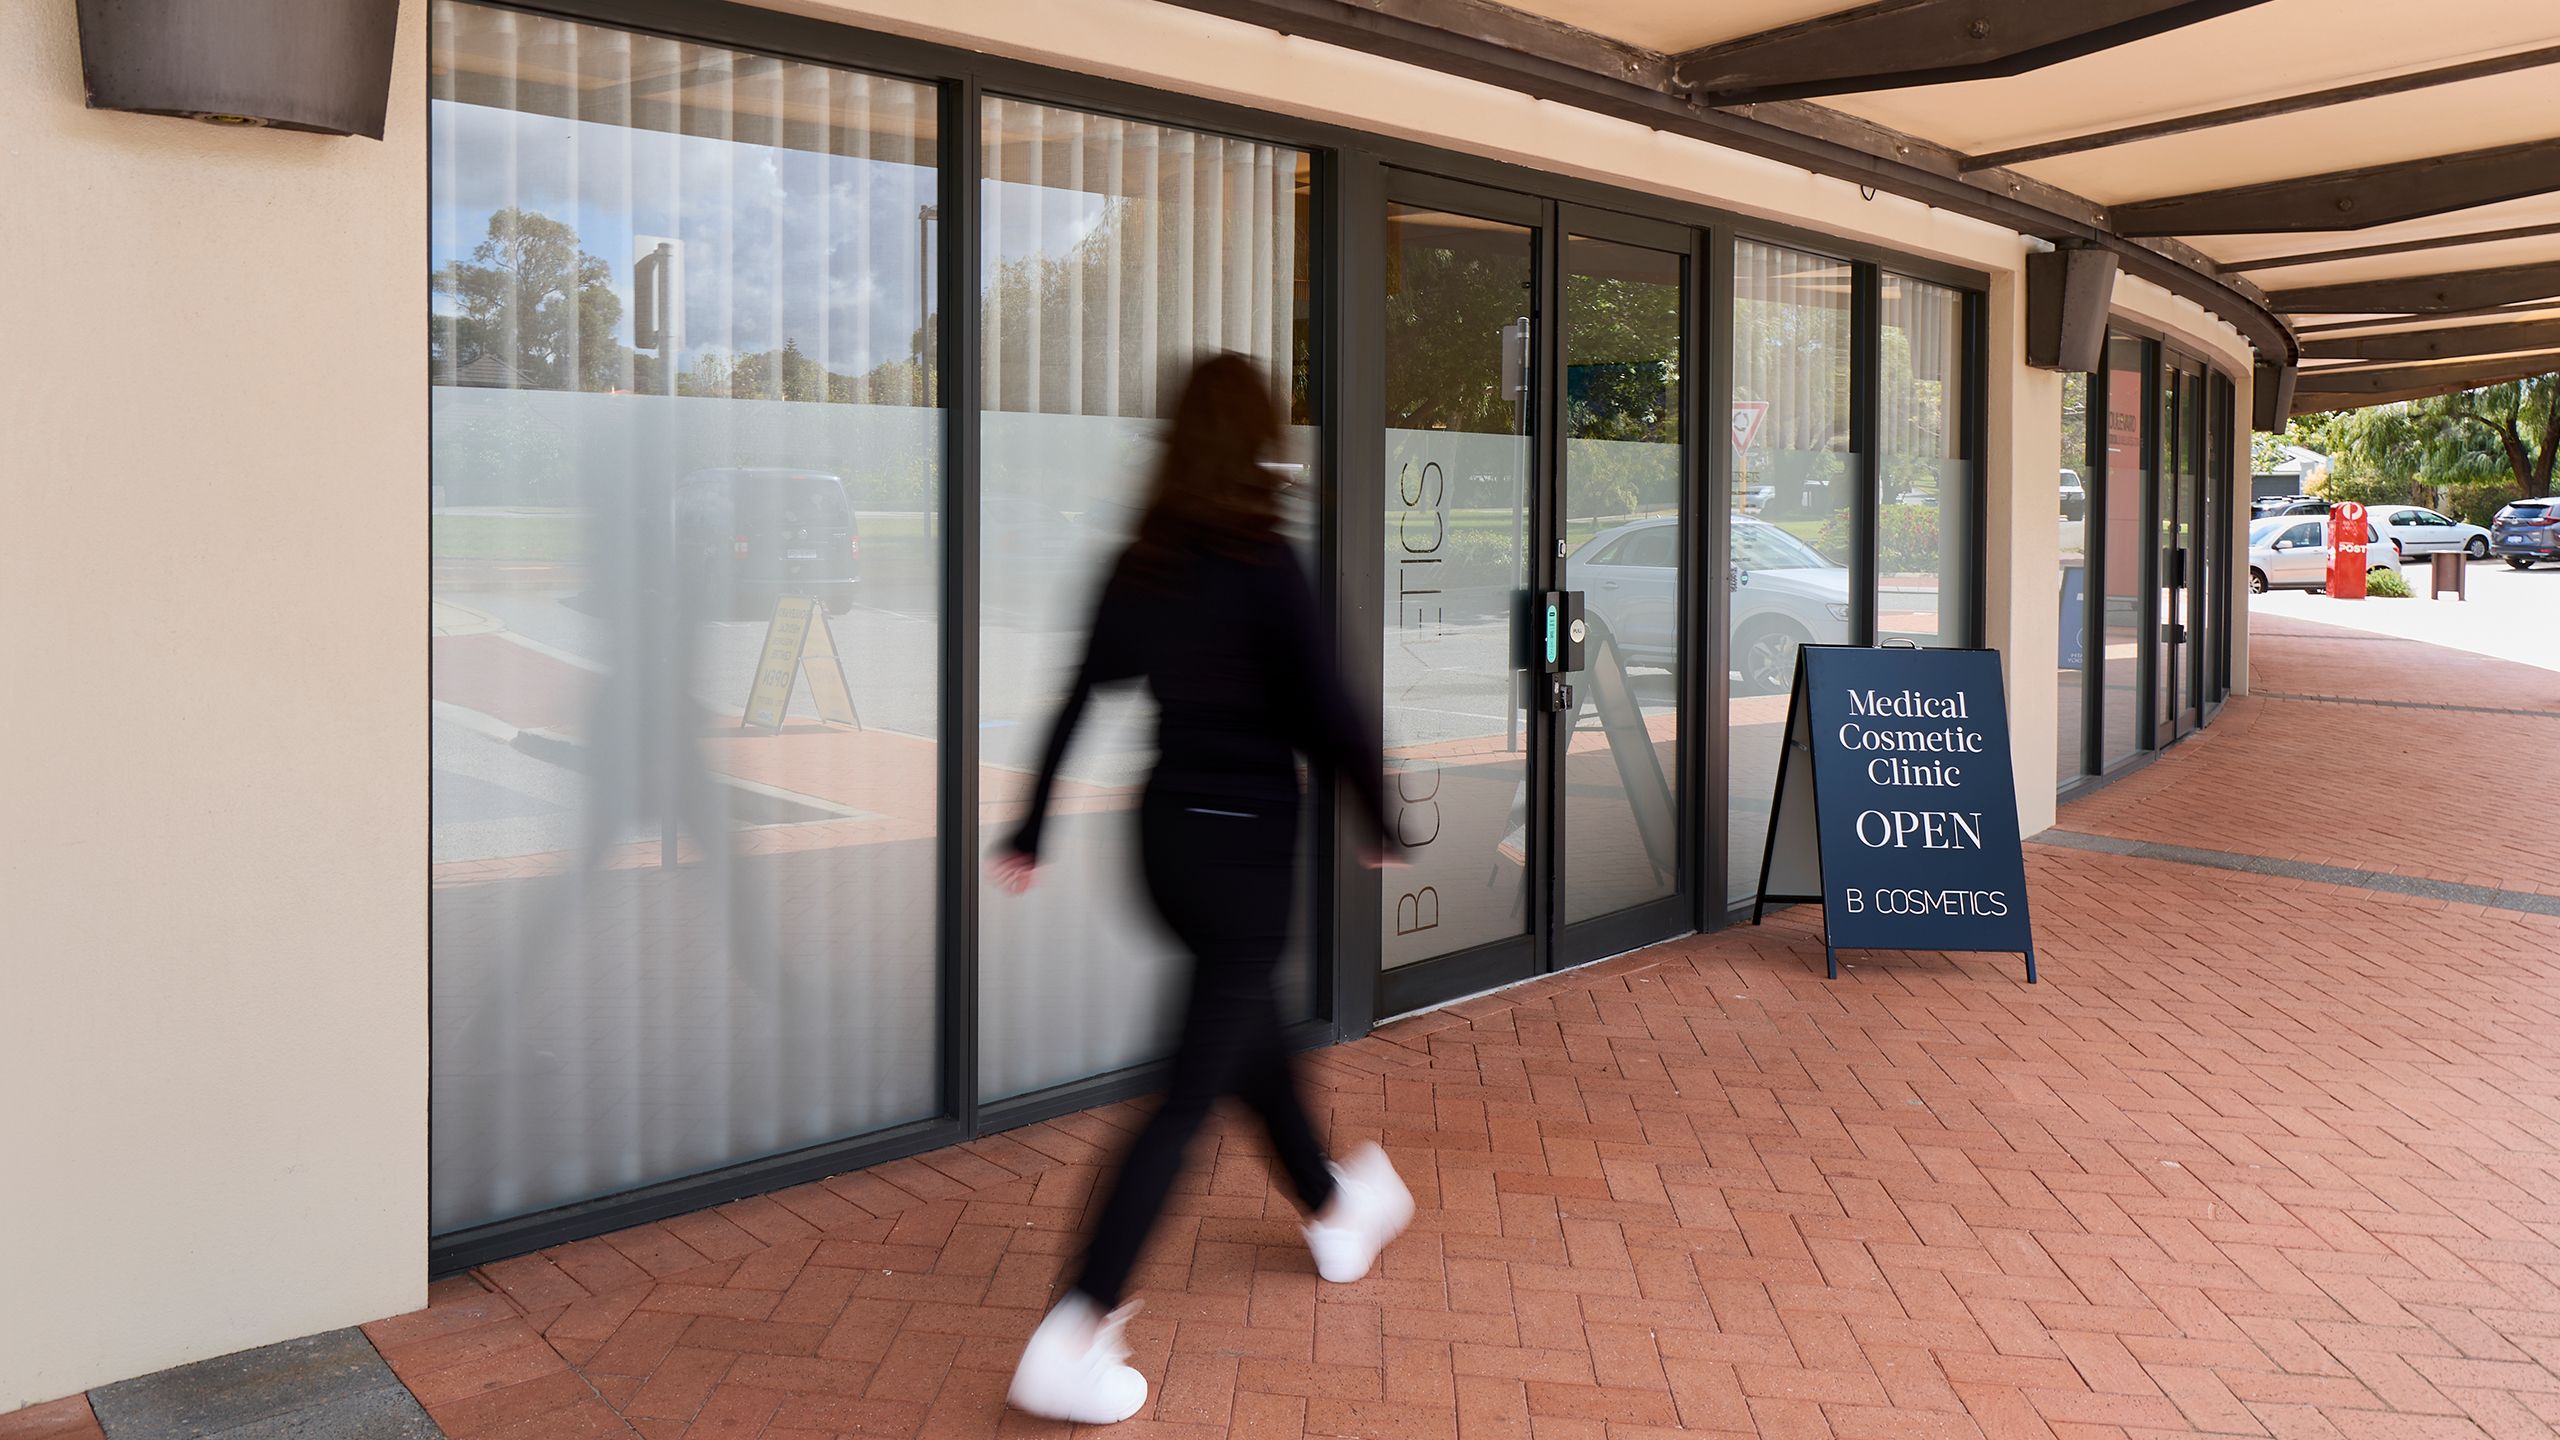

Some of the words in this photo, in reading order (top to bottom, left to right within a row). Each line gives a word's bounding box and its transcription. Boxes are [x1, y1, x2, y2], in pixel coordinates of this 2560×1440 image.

[2339, 544, 2367, 553] POST
[1397, 461, 1444, 849] COMETICS
[1847, 690, 1969, 719] Medical
[1839, 723, 1983, 753] Cosmetic
[1868, 758, 1961, 787] Clinic
[1856, 810, 1982, 850] OPEN
[1397, 885, 1439, 937] B
[1846, 889, 1865, 913] B
[1875, 889, 2008, 916] COSMETICS
